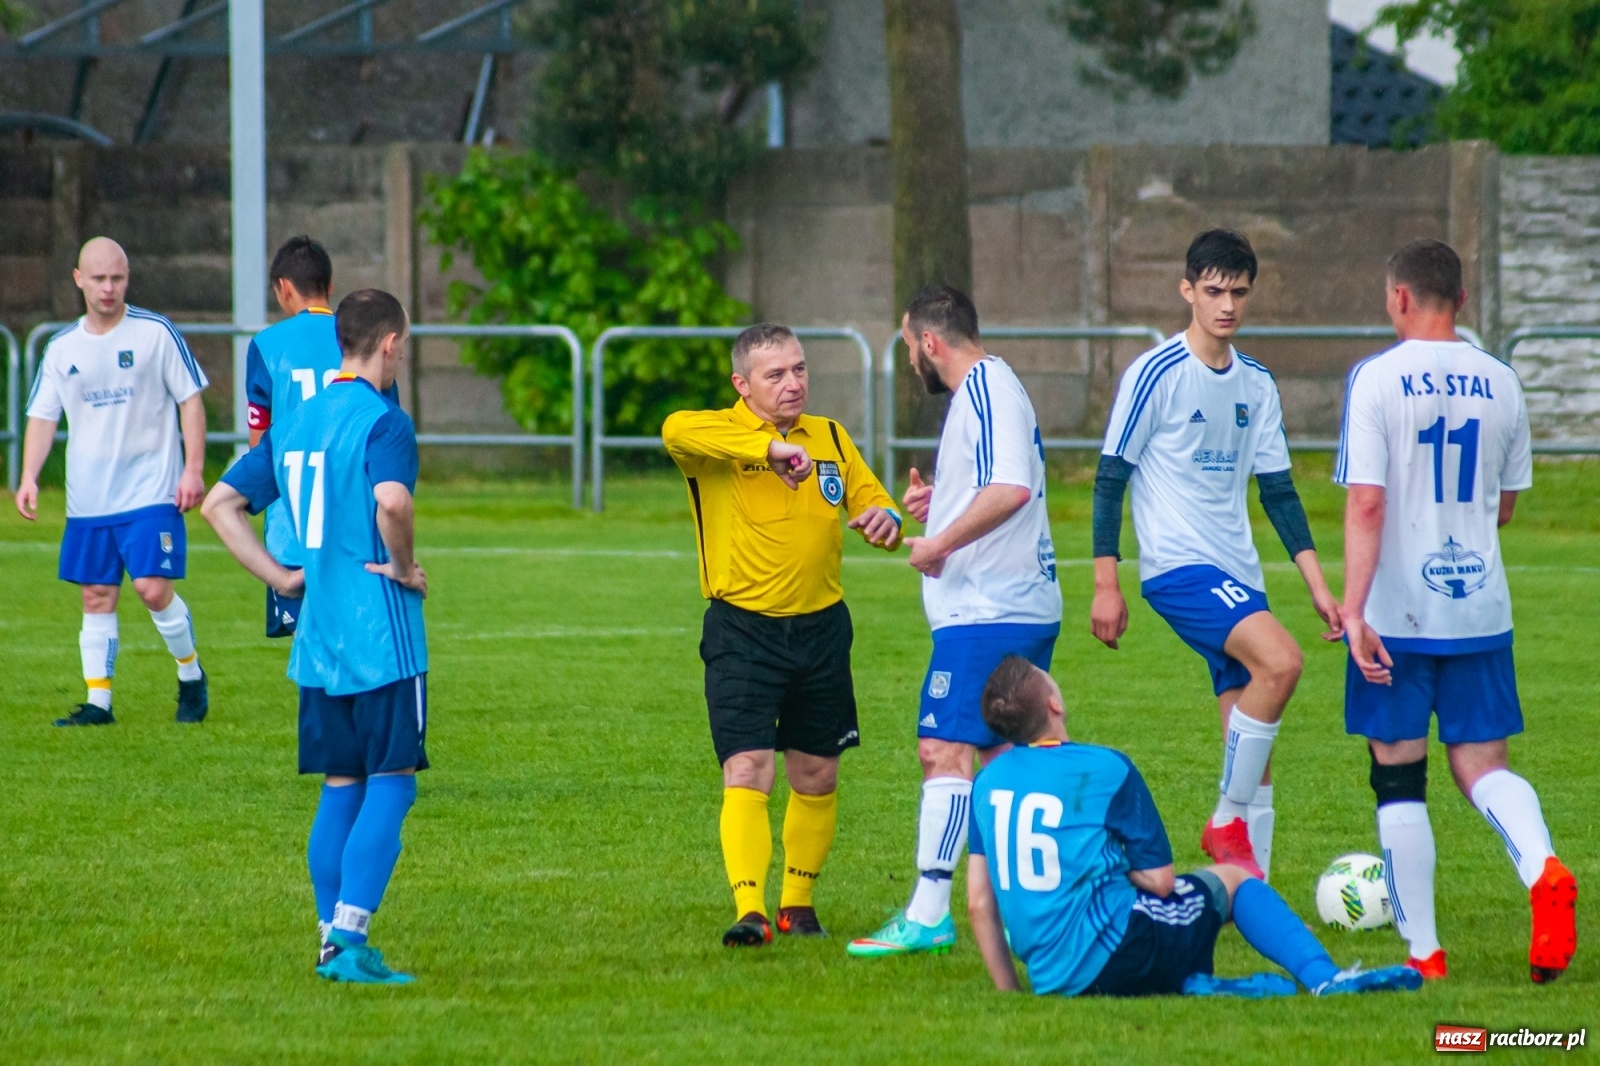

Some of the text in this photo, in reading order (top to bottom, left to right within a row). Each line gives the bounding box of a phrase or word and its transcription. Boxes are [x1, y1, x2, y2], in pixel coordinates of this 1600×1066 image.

[248, 406, 260, 425] C
[1400, 372, 1494, 400] K.S. STAL
[1418, 415, 1480, 503] 11
[283, 450, 325, 549] 11
[1210, 579, 1250, 610] 16
[989, 789, 1064, 892] 16
